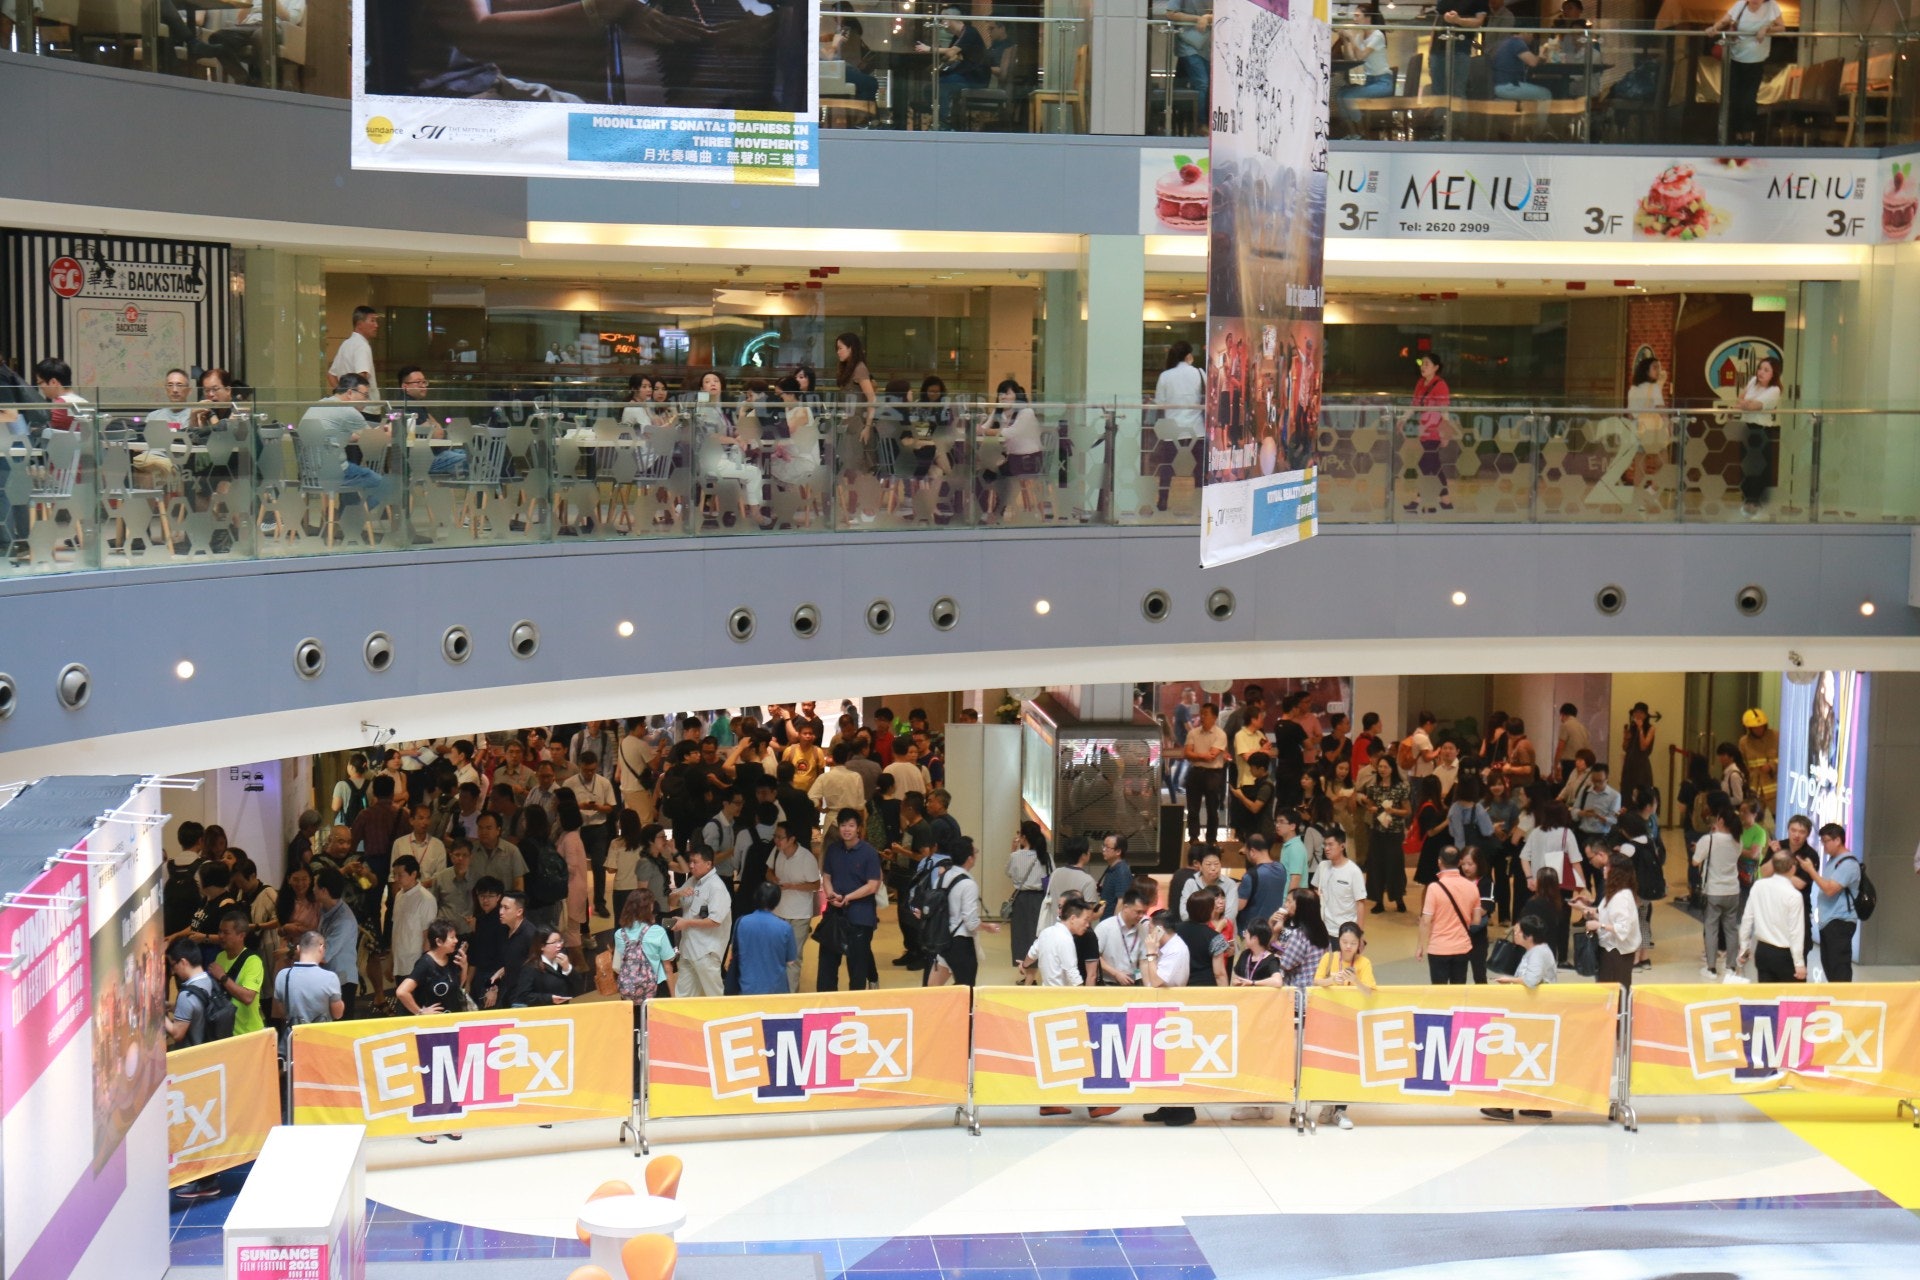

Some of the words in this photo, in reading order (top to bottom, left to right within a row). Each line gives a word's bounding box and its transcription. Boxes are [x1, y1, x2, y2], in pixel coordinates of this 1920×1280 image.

[365, 126, 404, 135] sundance
[592, 116, 667, 131] MOONLIGHT
[670, 120, 725, 132] SONATA:
[728, 121, 791, 134] DEAFNESS
[793, 124, 809, 135] IN
[692, 135, 732, 147] THREE
[735, 137, 809, 150] MOVEMENTS
[1400, 169, 1533, 211] MENU
[1767, 172, 1854, 199] MENU
[1339, 203, 1379, 231] 3/F
[1584, 207, 1623, 235] 3/F
[1825, 209, 1865, 237] 3/F
[1400, 222, 1422, 232] Tel:
[1426, 222, 1456, 232] 2620
[1460, 223, 1490, 233] 2909
[240, 1248, 319, 1261] SUNDANCE
[288, 1260, 319, 1270] 2019
